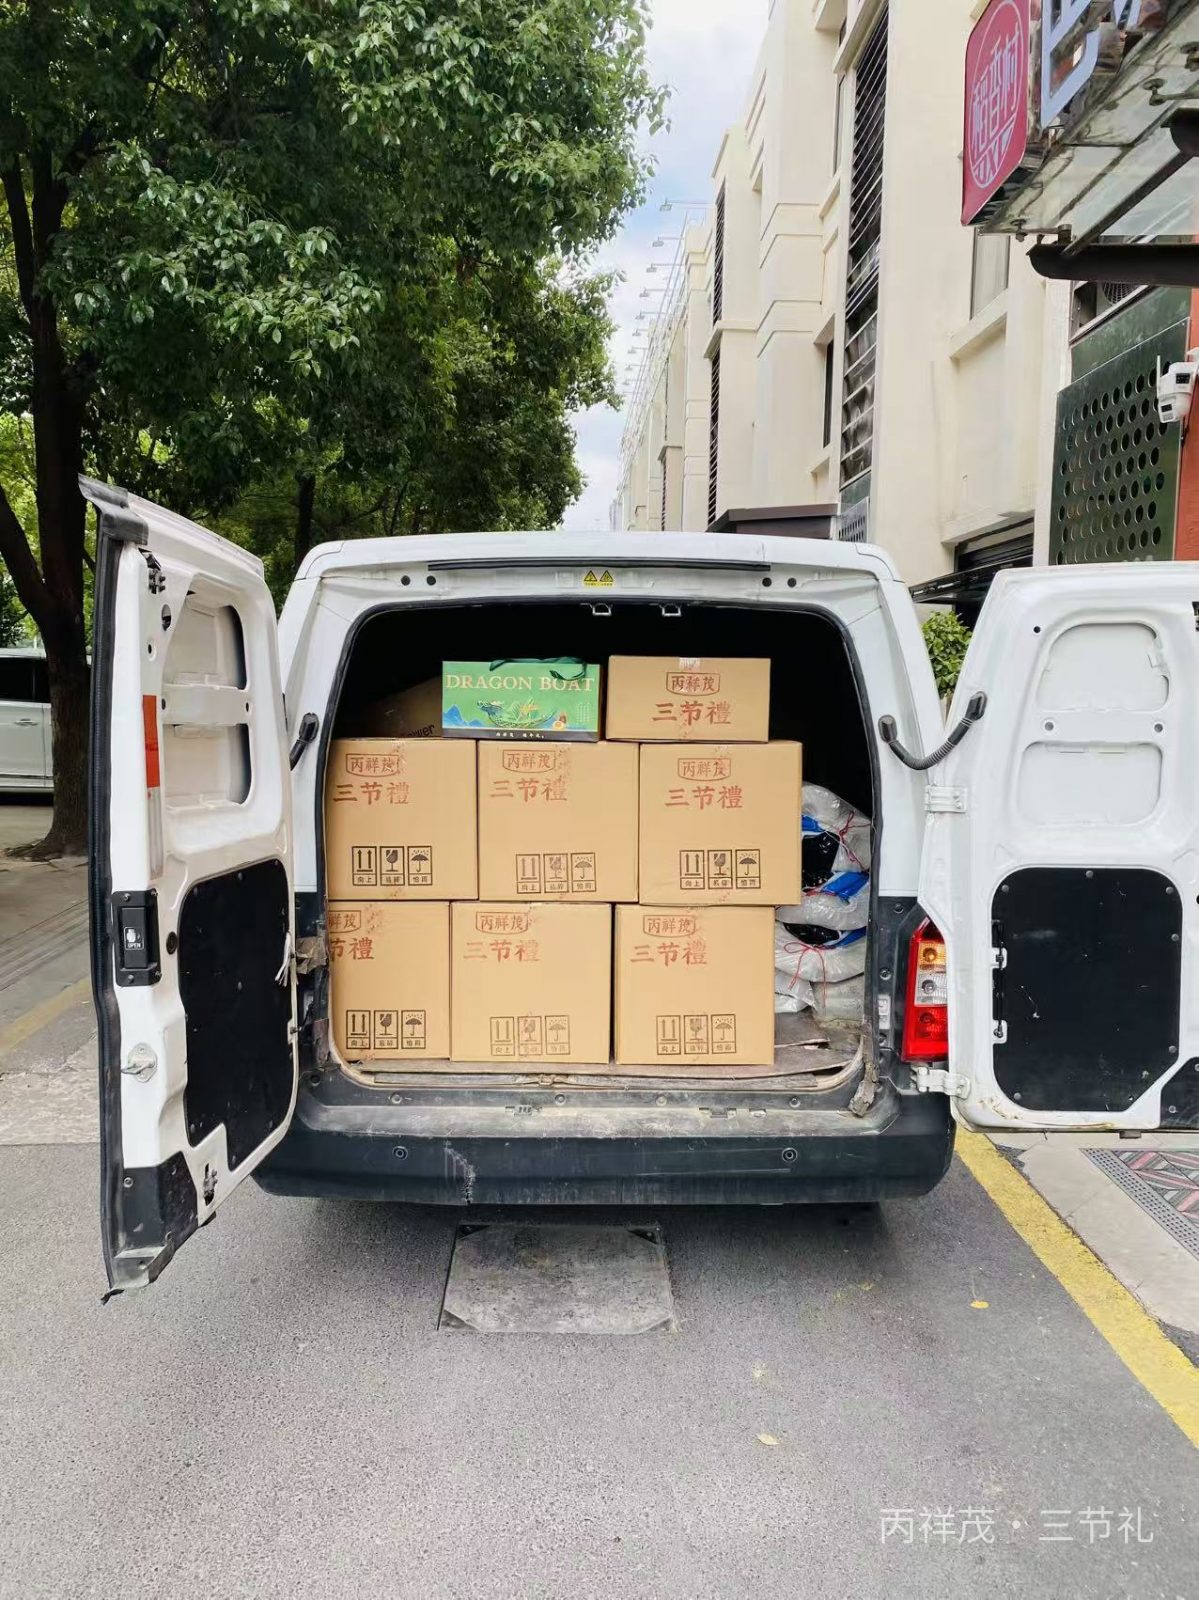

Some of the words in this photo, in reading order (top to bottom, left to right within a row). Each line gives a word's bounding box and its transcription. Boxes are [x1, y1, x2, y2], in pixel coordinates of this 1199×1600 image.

[445, 674, 532, 690] DRAGON
[539, 676, 594, 692] BOAT
[670, 674, 717, 692] 丙祥茂
[651, 700, 732, 725] 三节禮
[350, 754, 398, 774] 丙祥茂
[507, 752, 551, 769] 丙祥茂
[682, 760, 728, 778] 丙祥茂
[332, 781, 411, 805] 三节禮
[489, 777, 569, 803] 三节禮
[664, 785, 744, 810] 三节禮
[479, 914, 526, 931] 丙祥茂
[648, 916, 694, 935] 丙祥茂
[463, 938, 541, 962] 三节禮
[629, 940, 708, 967] 三节禮
